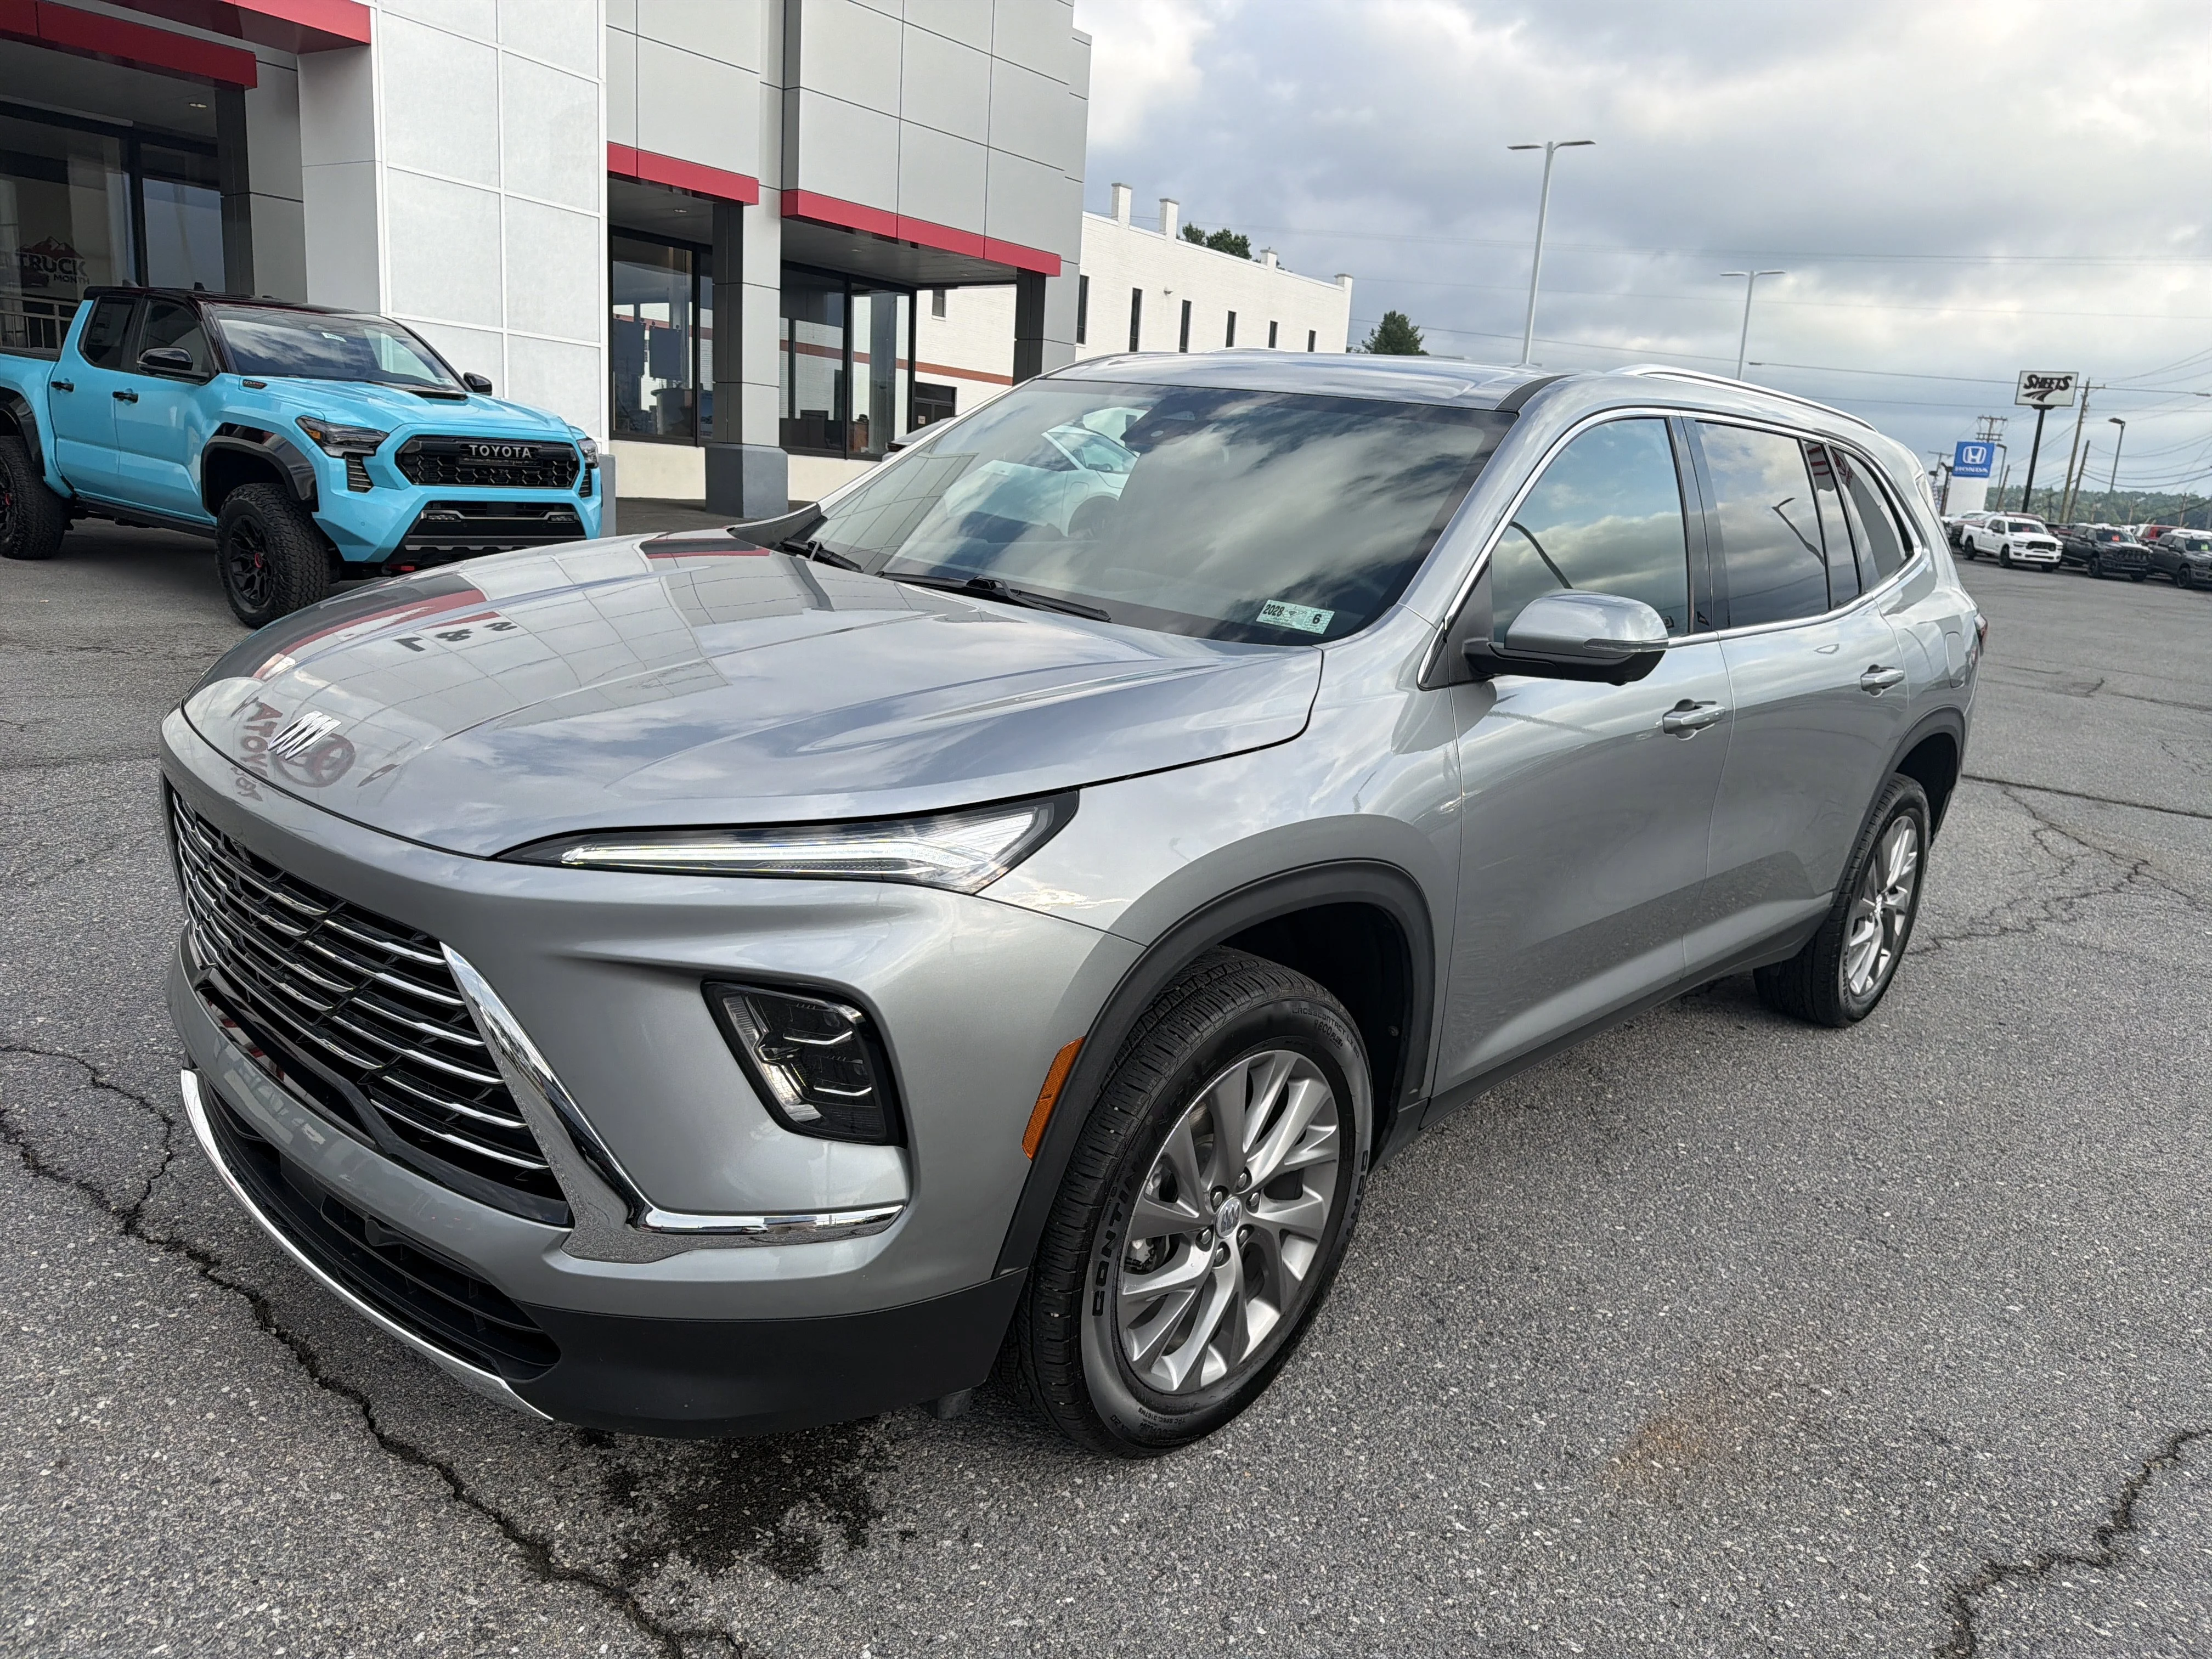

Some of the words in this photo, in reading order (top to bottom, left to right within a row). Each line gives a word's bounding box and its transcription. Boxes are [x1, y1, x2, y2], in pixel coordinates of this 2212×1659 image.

[15, 252, 88, 277] TRUCK
[53, 273, 89, 285] MONTH
[469, 445, 532, 458] TOYOTA
[1262, 604, 1285, 616] 2028
[1312, 613, 1322, 624] 6
